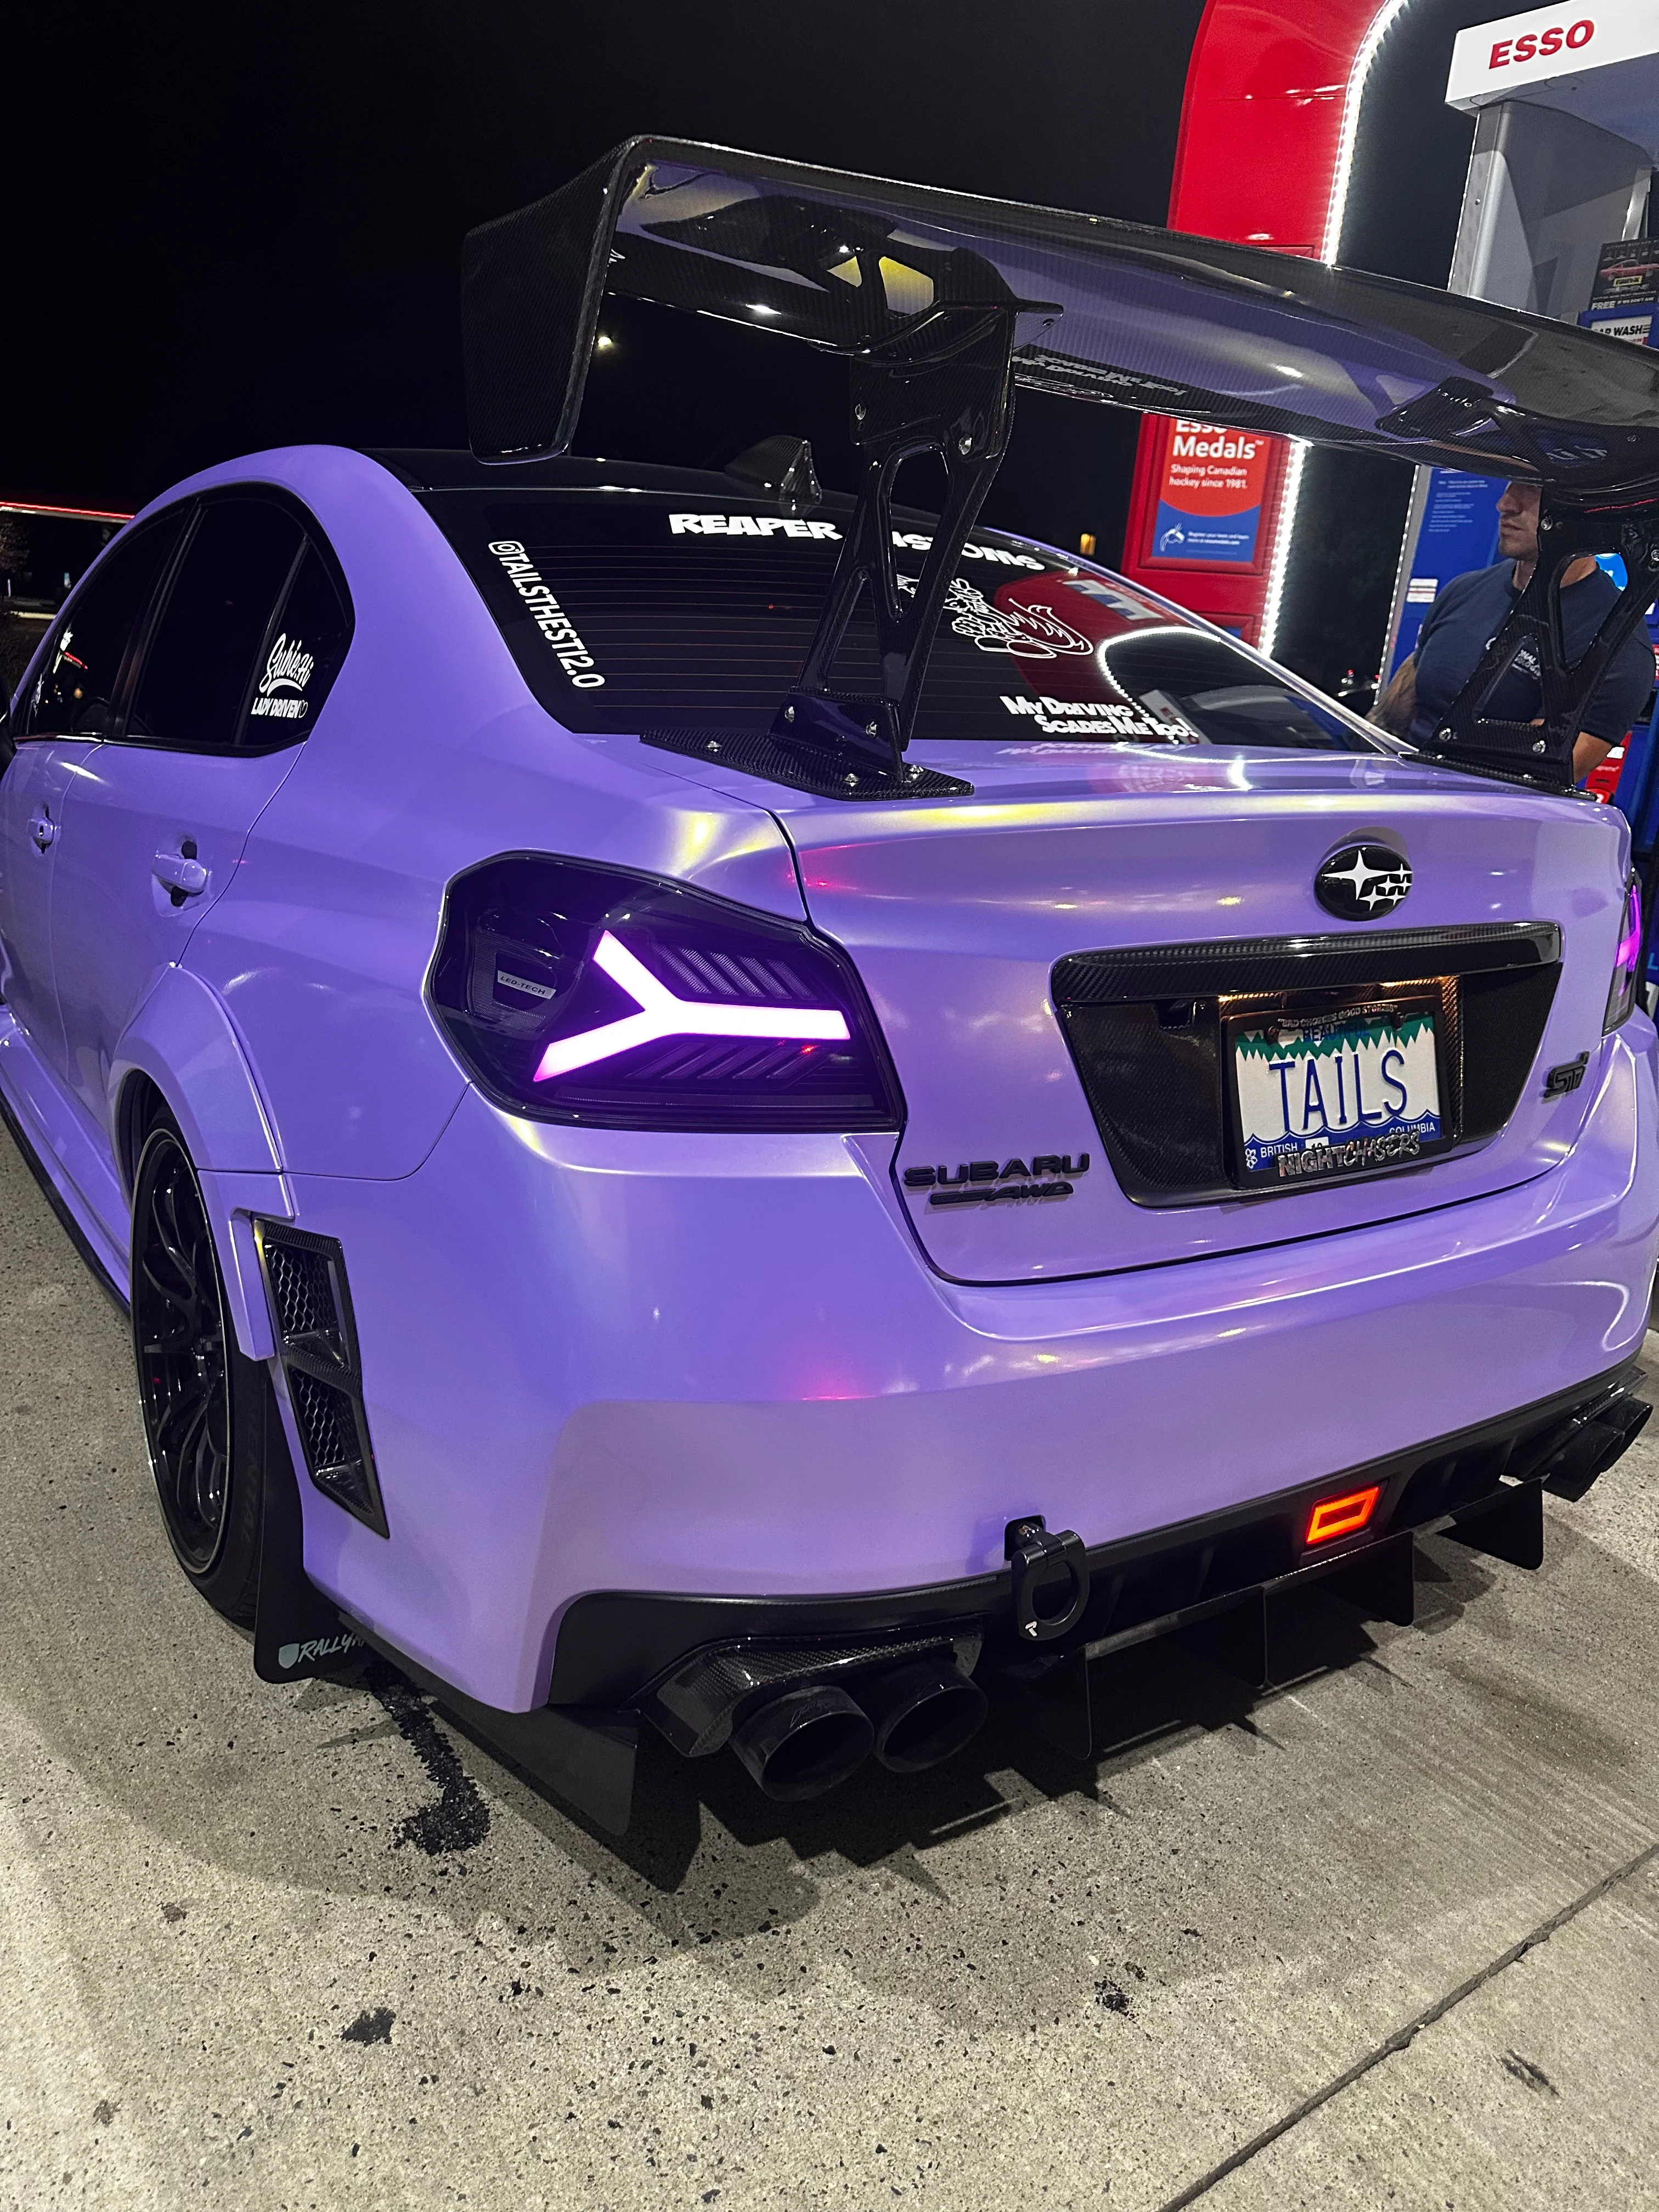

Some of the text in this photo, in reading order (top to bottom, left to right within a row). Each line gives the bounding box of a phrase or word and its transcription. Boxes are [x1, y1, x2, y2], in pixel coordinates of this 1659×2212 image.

[1488, 20, 1595, 69] ESSO
[1591, 301, 1616, 311] FREE
[1613, 325, 1643, 336] WASH
[1171, 464, 1247, 477] Shaping Canadian
[1169, 476, 1200, 489] hockey
[1201, 478, 1224, 487] since
[669, 513, 843, 540] REAPER
[251, 697, 301, 718] LADY DRIVEN
[500, 976, 546, 995] LED-TECH
[1300, 1013, 1338, 1027] CHOICES
[1338, 1007, 1361, 1020] GOOD
[1302, 1022, 1370, 1042] BEAUTIFUL
[1269, 1049, 1408, 1133] TAILS
[1260, 1142, 1298, 1159] BRITISH
[1389, 1121, 1436, 1136] COLUMBIA
[904, 1153, 1090, 1187] SUBARU
[984, 1181, 1074, 1202] AWD
